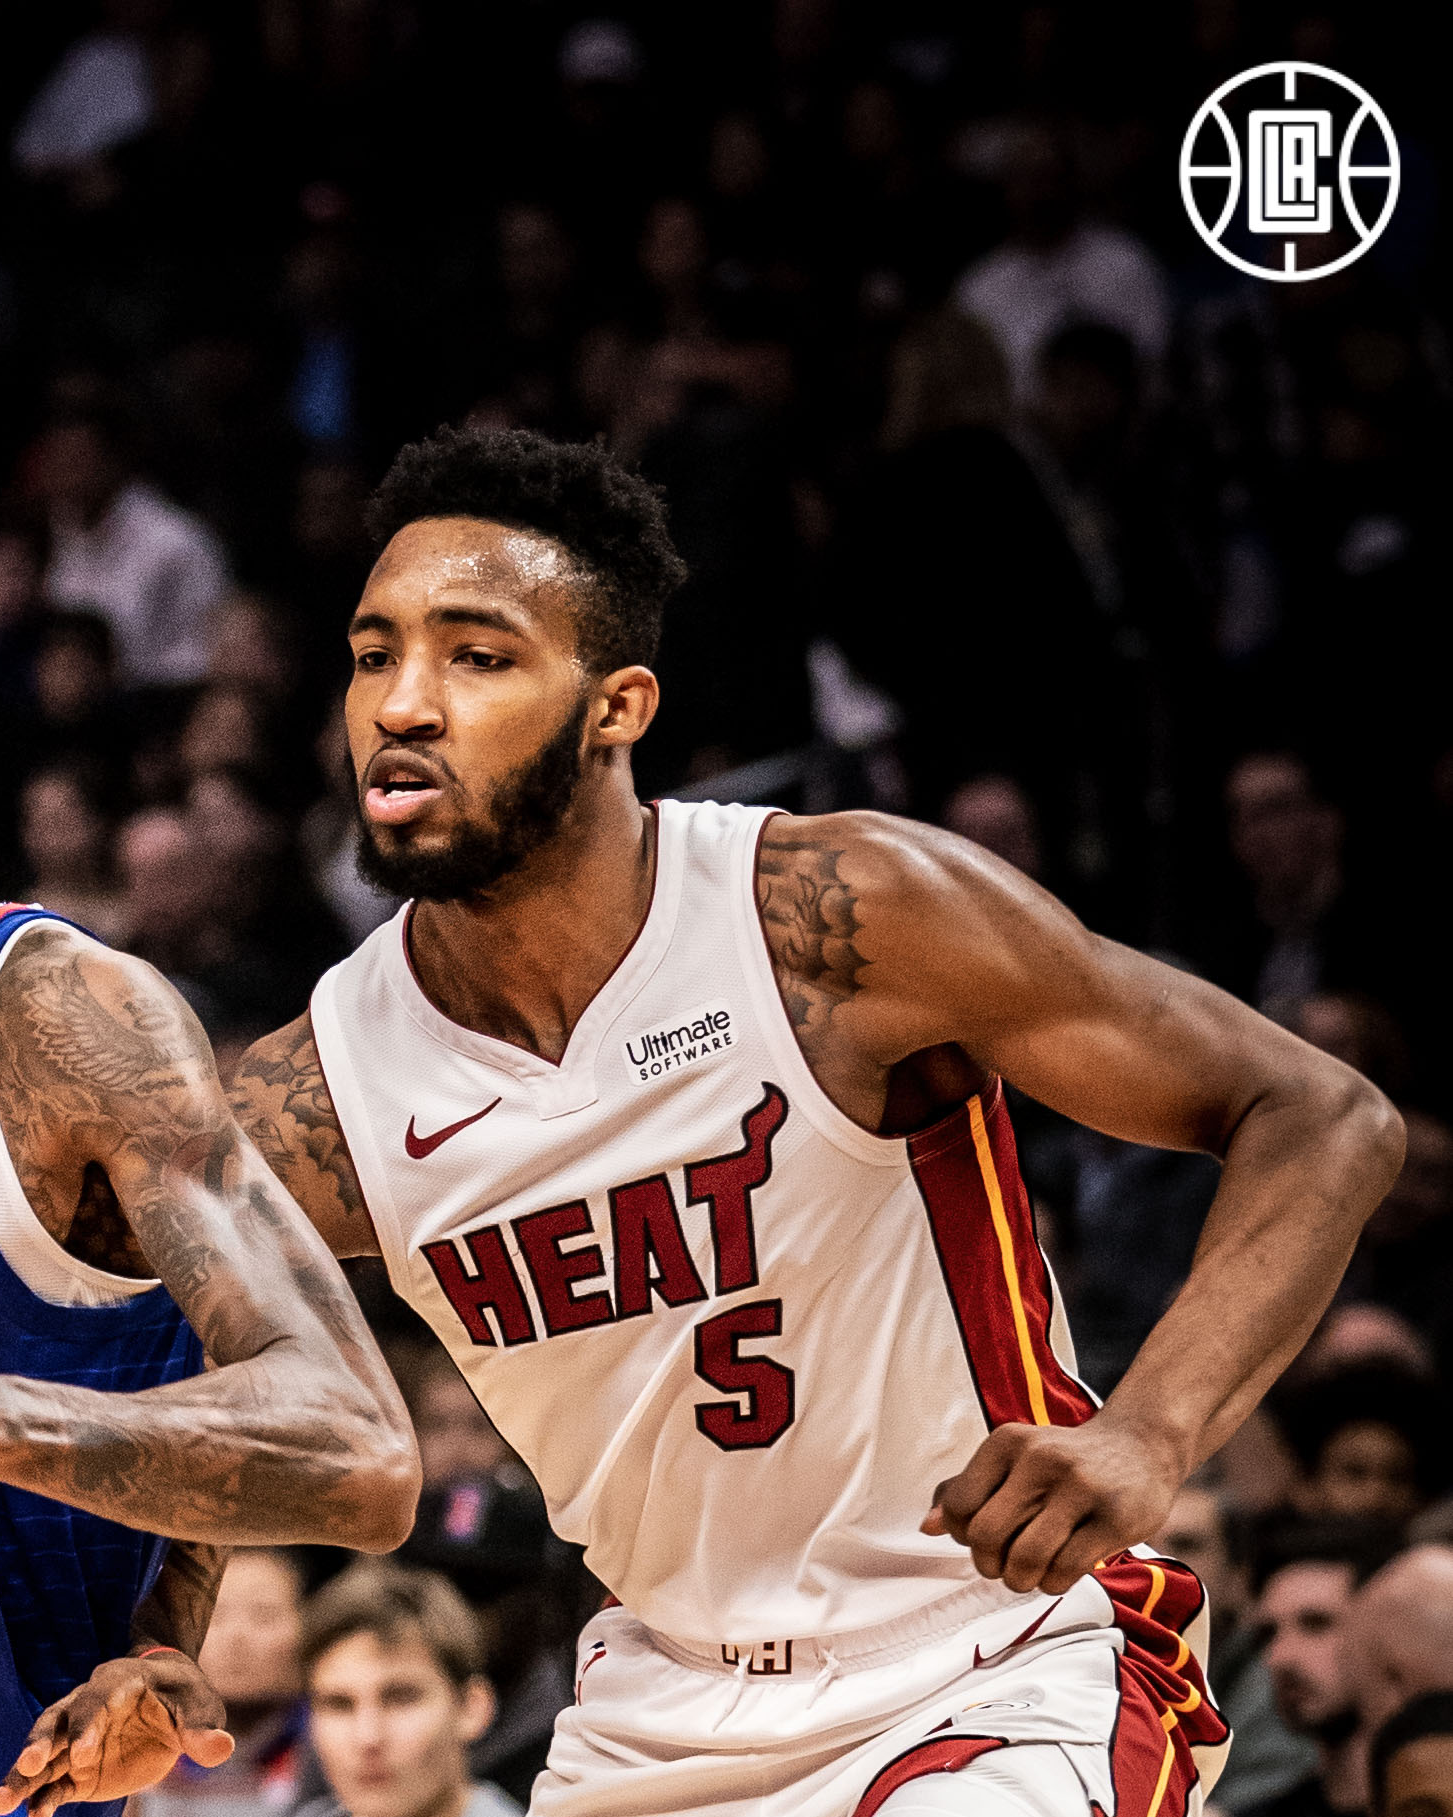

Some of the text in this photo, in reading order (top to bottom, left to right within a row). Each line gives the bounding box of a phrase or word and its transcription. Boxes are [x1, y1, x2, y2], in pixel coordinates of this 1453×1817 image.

[625, 1010, 731, 1066] Ultimate
[639, 1032, 733, 1081] SOFTWARE
[418, 1080, 790, 1348] HEAT
[693, 1298, 796, 1452] 5
